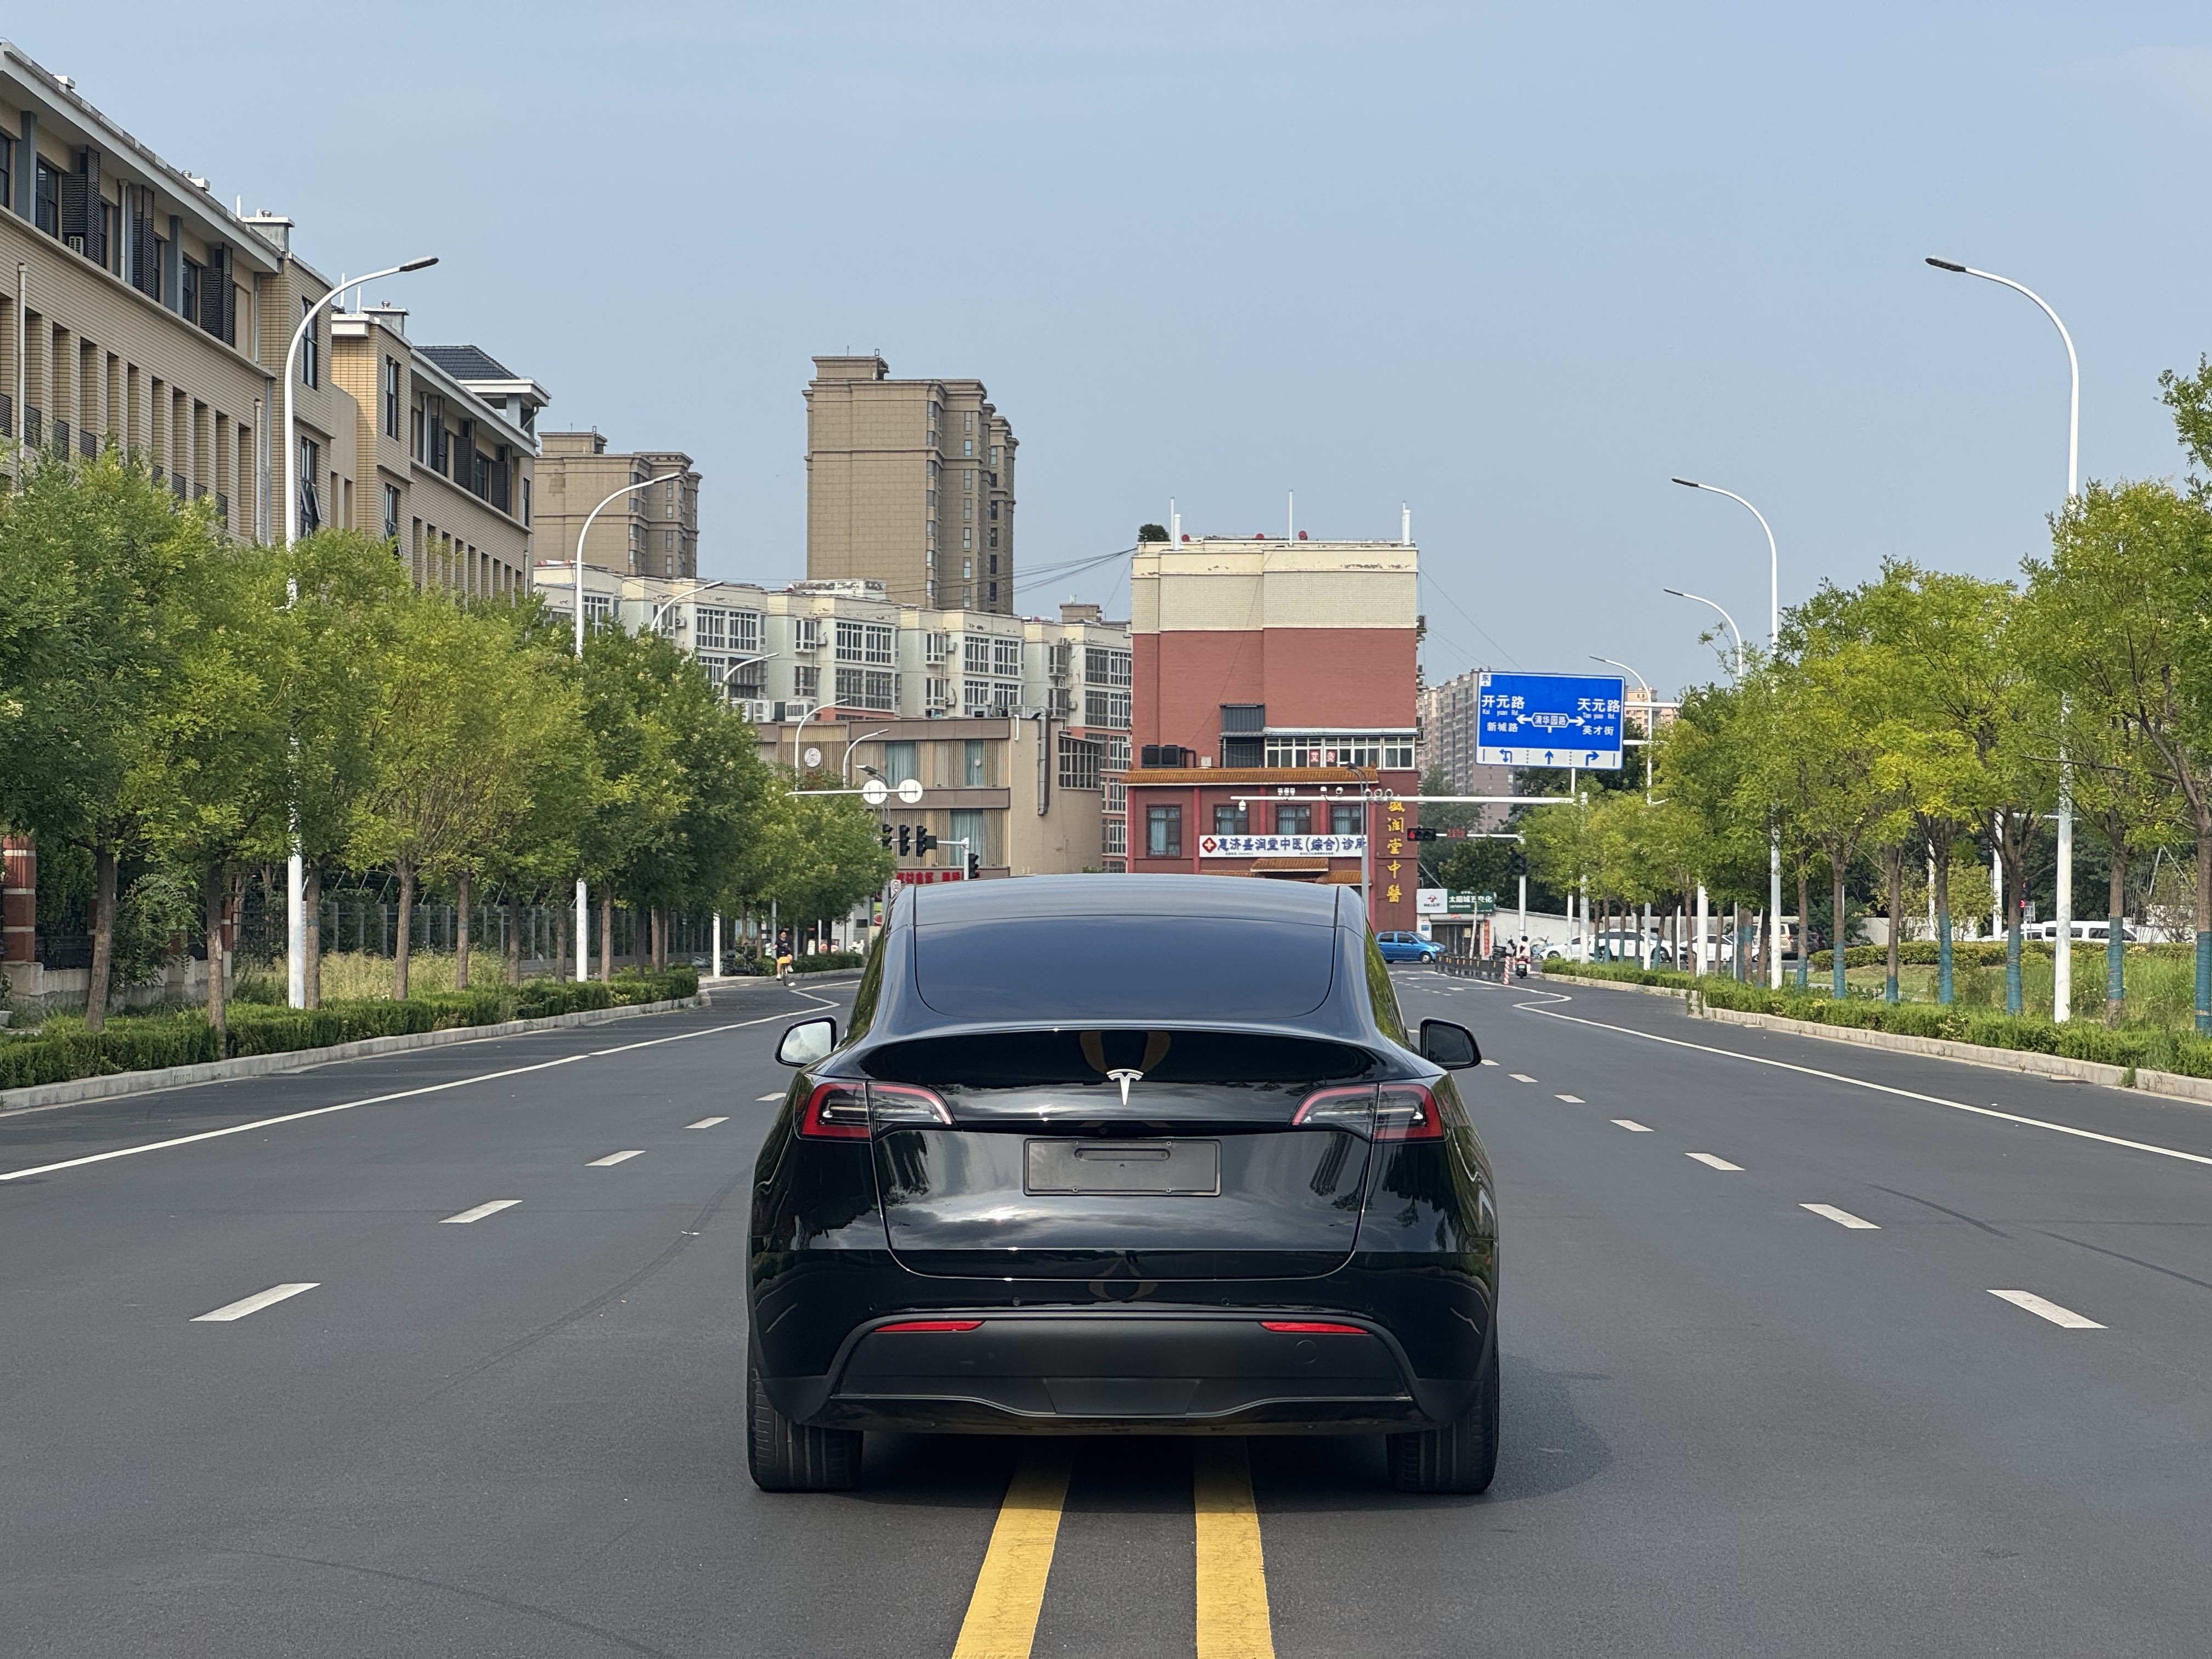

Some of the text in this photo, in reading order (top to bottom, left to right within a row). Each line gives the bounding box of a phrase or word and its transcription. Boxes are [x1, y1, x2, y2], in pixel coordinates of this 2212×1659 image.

[1481, 695, 1525, 709] 开元路
[1577, 698, 1620, 713] 天元路
[1486, 721, 1519, 732] 新城路
[1582, 725, 1615, 736] 英才街
